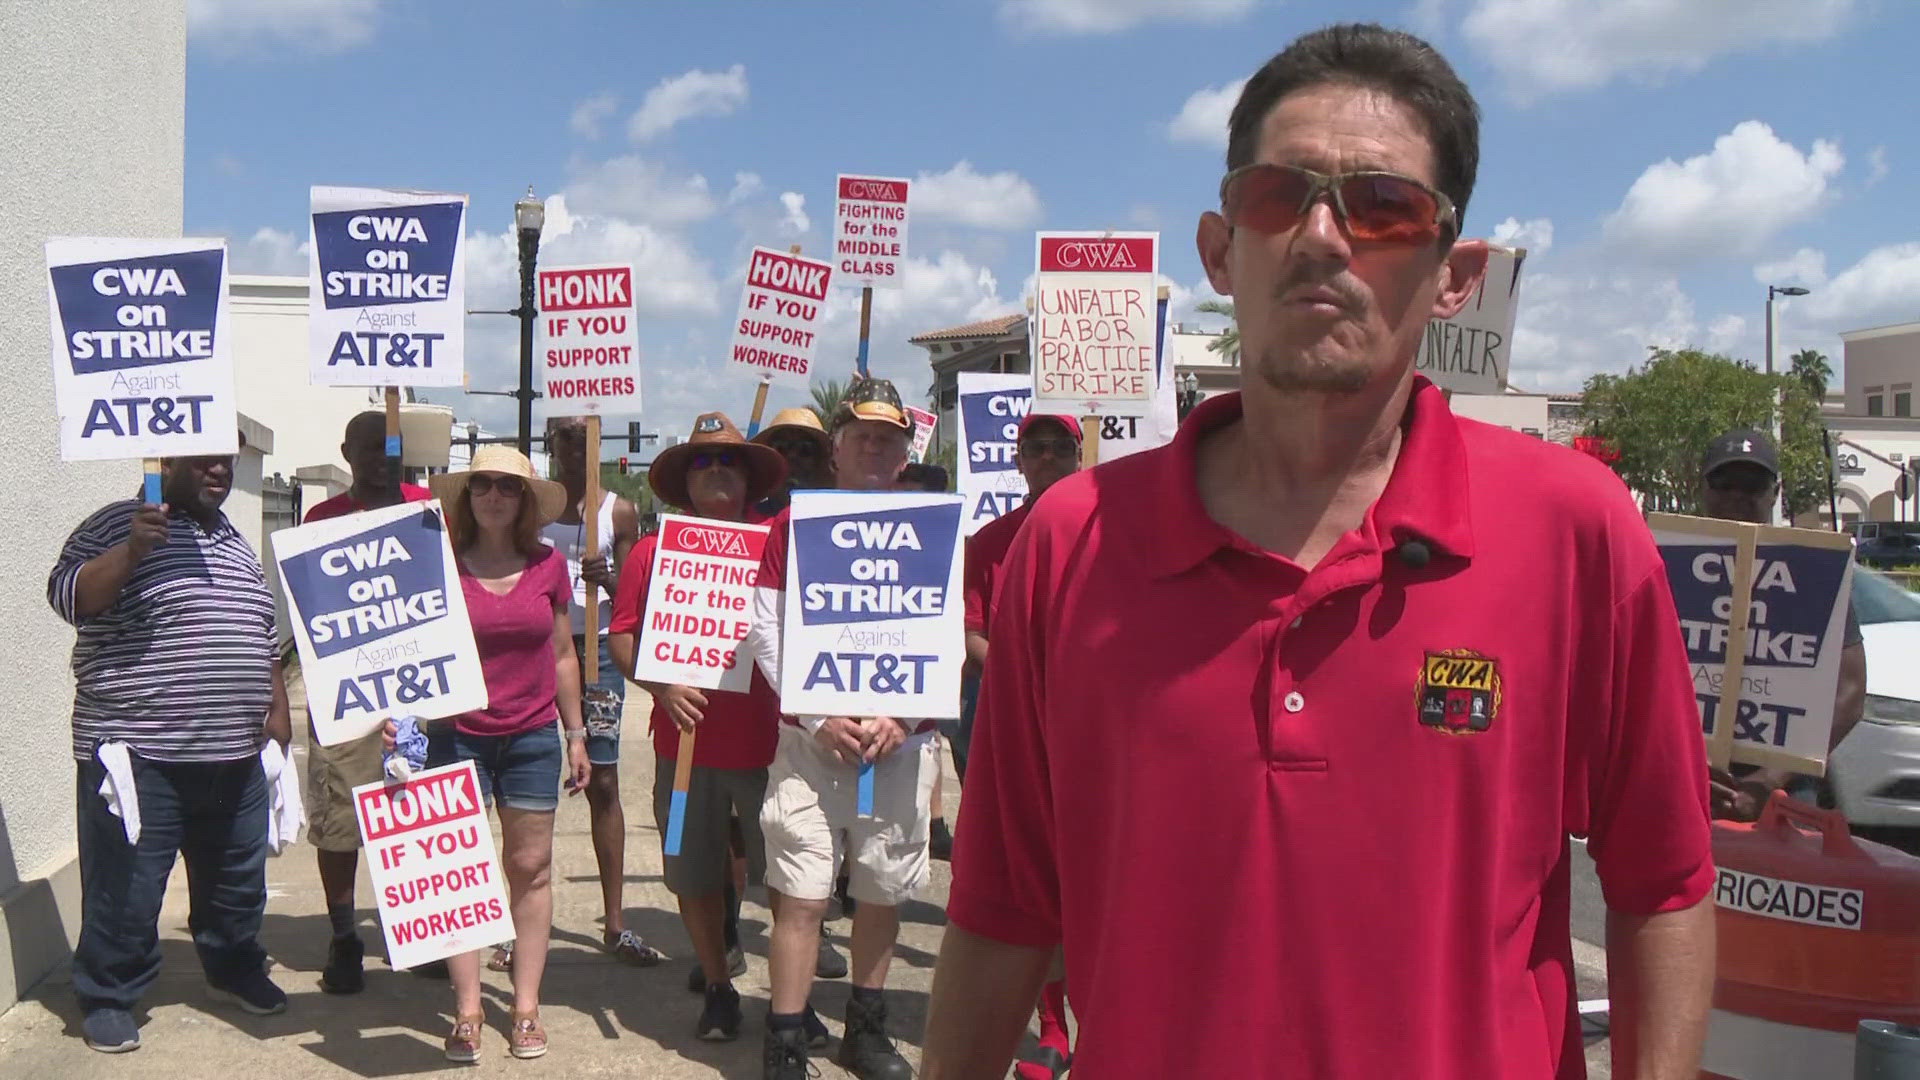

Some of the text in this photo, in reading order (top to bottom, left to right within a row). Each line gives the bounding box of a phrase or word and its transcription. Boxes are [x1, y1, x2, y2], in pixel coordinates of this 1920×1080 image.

[848, 181, 899, 201] CWA
[838, 203, 905, 221] FIGHTING
[347, 216, 428, 243] CWA
[843, 221, 898, 238] for the
[365, 249, 408, 270] on
[838, 241, 901, 256] MIDDLE
[1057, 243, 1136, 268] CWA
[92, 268, 187, 297] CWA
[751, 258, 828, 296] HONK
[841, 260, 895, 276] CLASS
[326, 273, 448, 299] STRIKE
[544, 272, 628, 306] HONK
[117, 304, 166, 327] on
[748, 293, 817, 321] IF YOU
[1041, 289, 1146, 318] UNFAIR
[356, 307, 418, 330] Against
[548, 315, 627, 337] IF YOU
[1041, 318, 1135, 342] LABOR
[72, 329, 212, 360] STRIKE
[739, 319, 814, 349] SUPPORT
[328, 331, 445, 368] AT&T
[547, 346, 632, 368] SUPPORT
[733, 344, 808, 375] WORKERS
[1040, 342, 1152, 372] PRACTICE
[111, 371, 181, 396] Against
[548, 376, 635, 399] WORKERS
[1041, 373, 1144, 394] STRIKE
[81, 394, 213, 438] AT&T
[988, 395, 1031, 417] CW
[1002, 423, 1019, 440] o
[973, 491, 1029, 520] AT
[677, 526, 750, 556] CWA
[830, 521, 922, 550] CWA
[319, 535, 411, 576] CWA
[850, 558, 899, 582] on
[659, 557, 758, 588] FIGHTING
[348, 574, 397, 602] on
[665, 584, 746, 611] for the
[804, 582, 943, 615] STRIKE
[310, 589, 447, 644] STRIKE
[652, 611, 749, 641] MIDDLE
[837, 625, 907, 651] Against
[1680, 619, 1817, 666] TRIKE
[355, 638, 422, 669] Against
[655, 642, 737, 671] CLASS
[334, 654, 456, 721] AT&T
[802, 652, 939, 695] AT&T
[1430, 659, 1489, 687] CWA
[1693, 665, 1772, 696] Agnst
[1696, 693, 1806, 747] T&T
[364, 774, 474, 834] HONK
[380, 826, 479, 870] IF YOU
[385, 861, 490, 908] SUPPORT
[1716, 870, 1860, 926] RICADES
[392, 898, 503, 945] WORKERS
